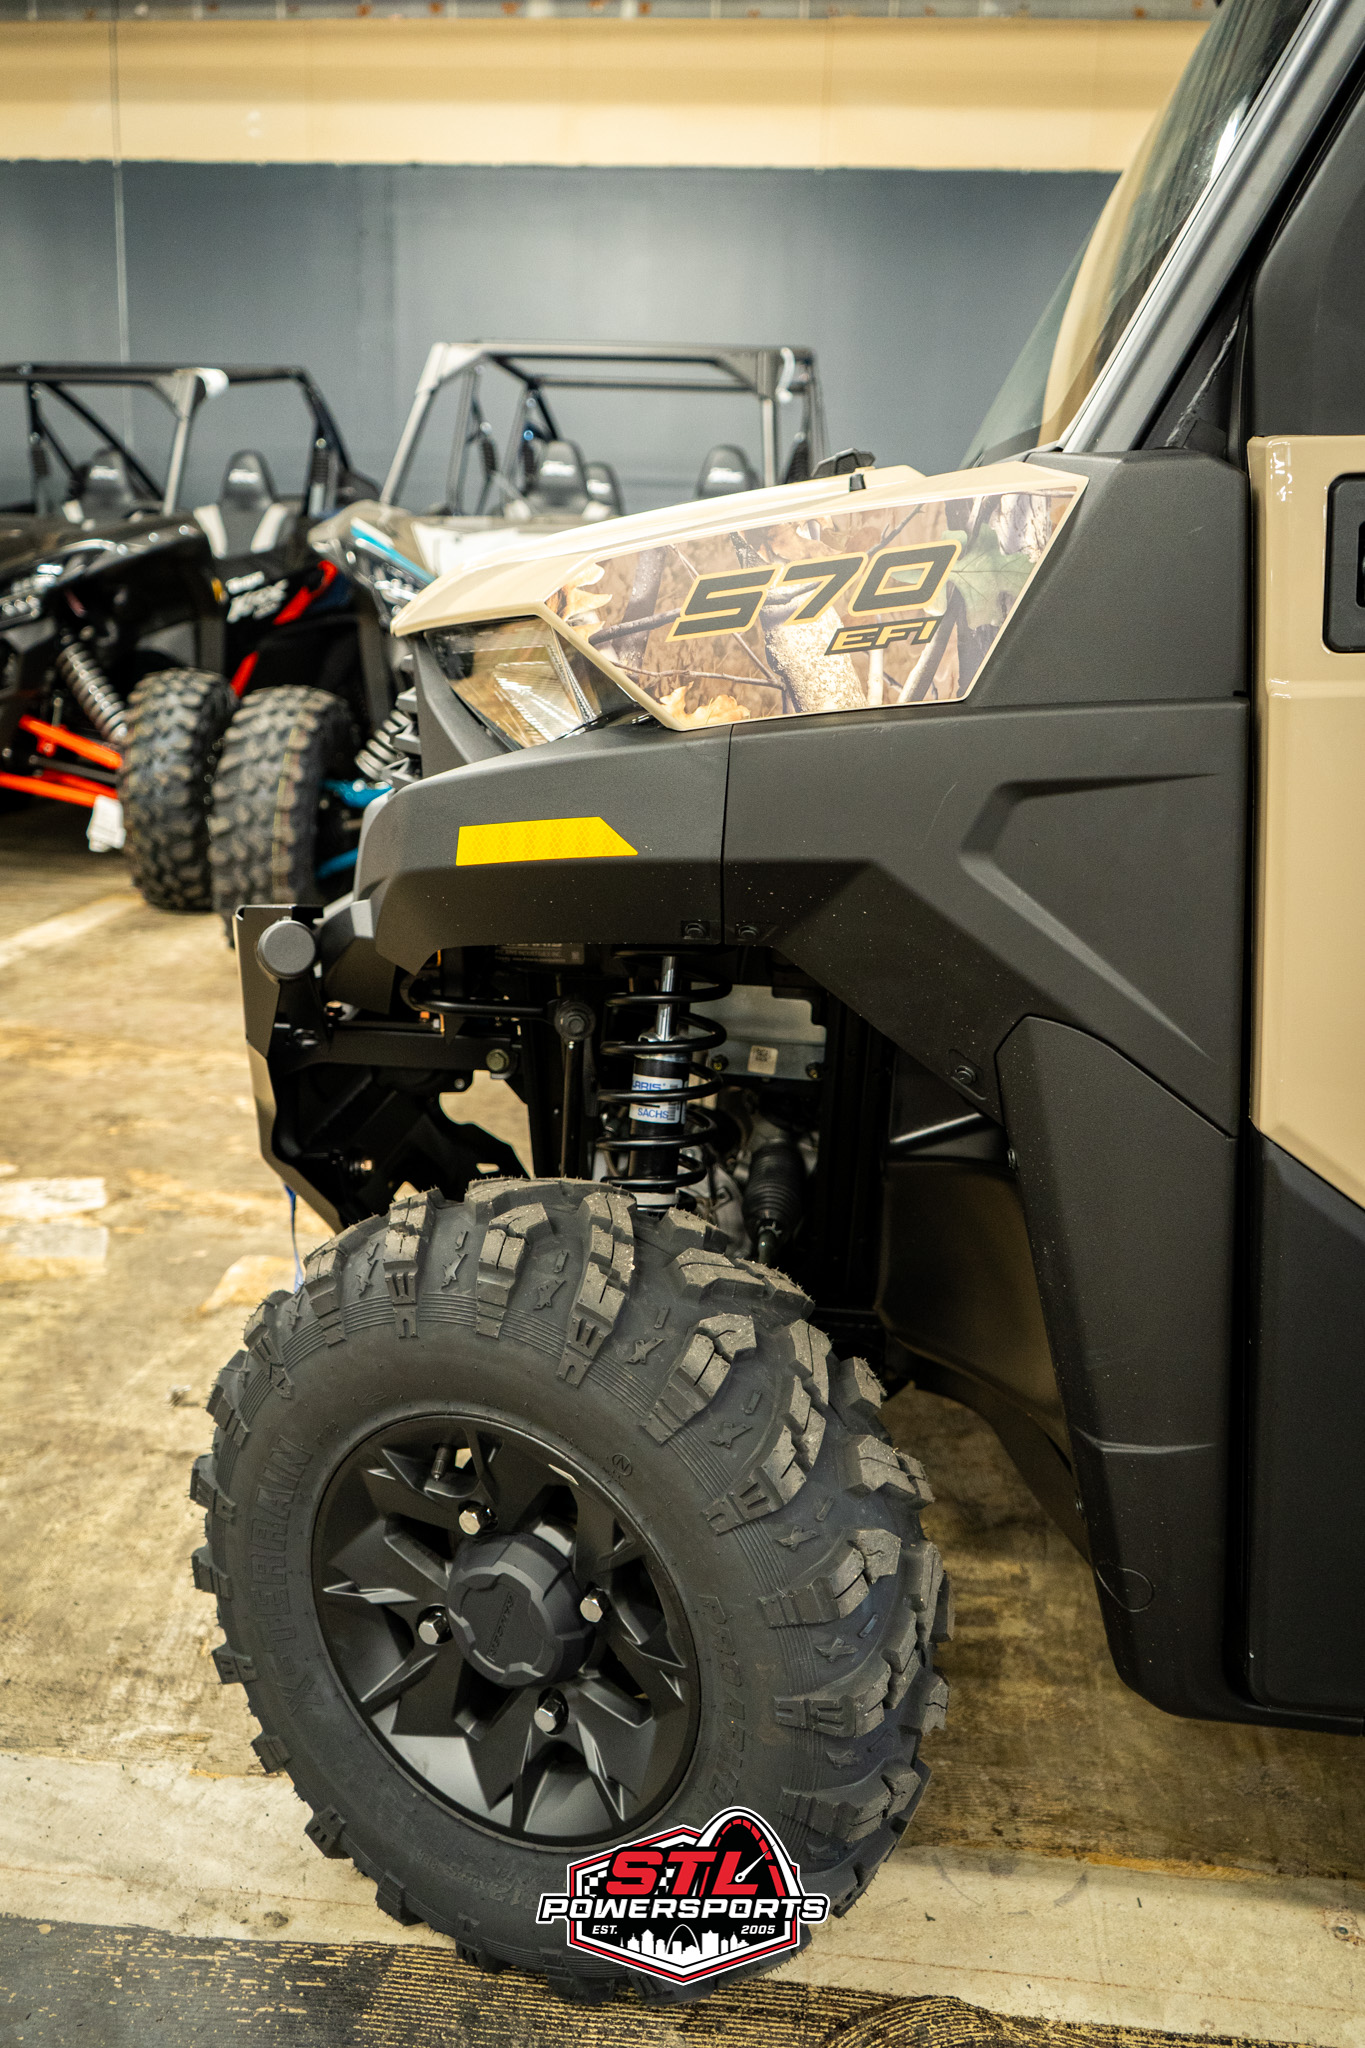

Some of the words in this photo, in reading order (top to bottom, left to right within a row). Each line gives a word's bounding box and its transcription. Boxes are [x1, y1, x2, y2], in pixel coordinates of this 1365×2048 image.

[665, 540, 962, 642] 570
[824, 614, 945, 656] EFI
[638, 1108, 669, 1119] SACHS
